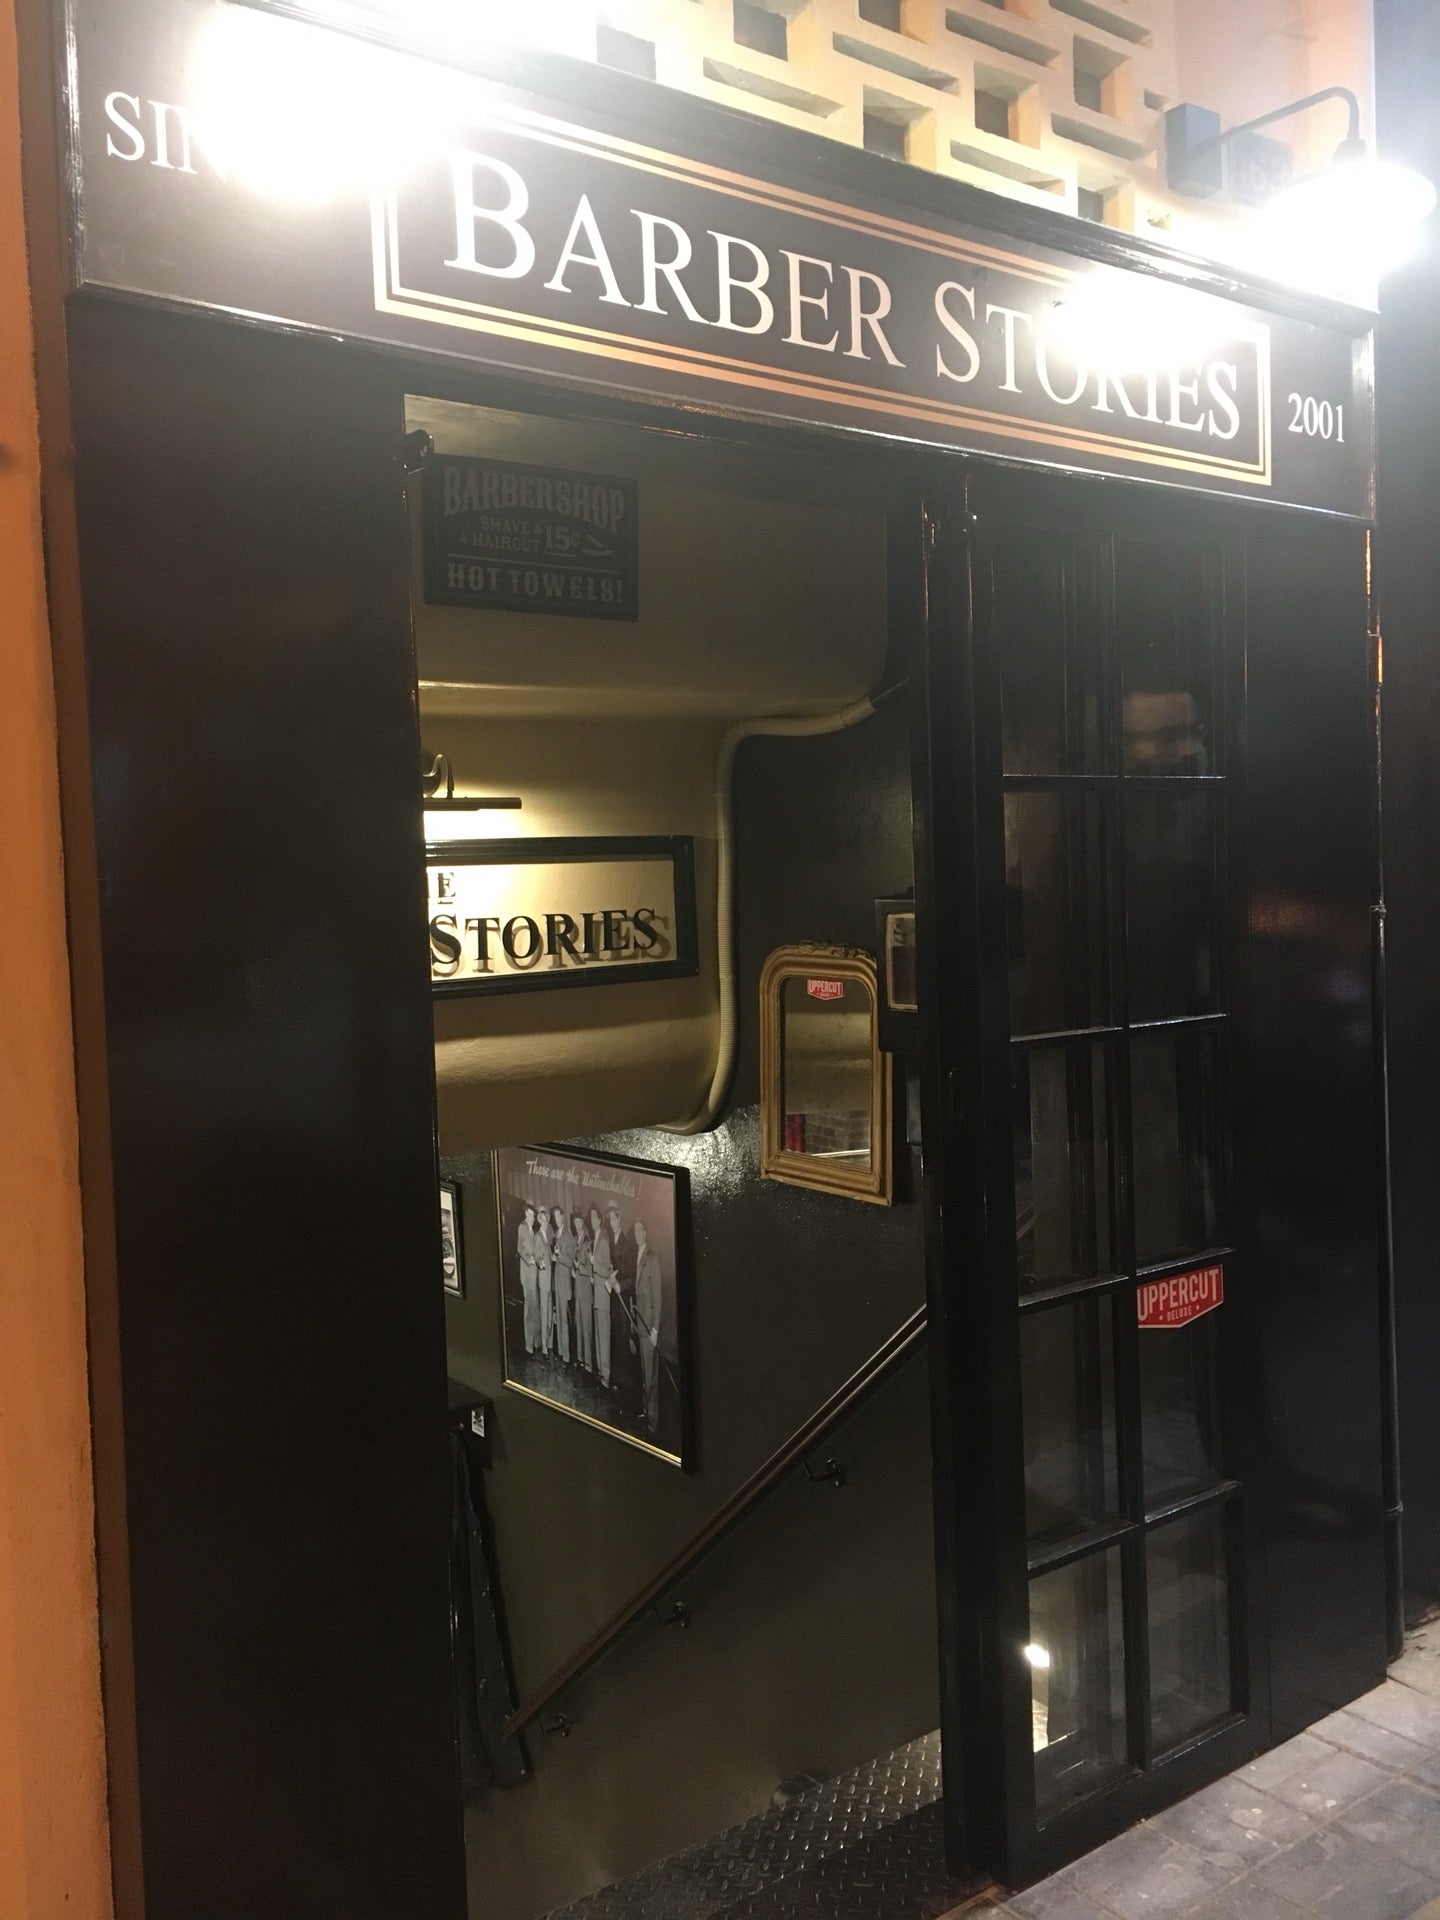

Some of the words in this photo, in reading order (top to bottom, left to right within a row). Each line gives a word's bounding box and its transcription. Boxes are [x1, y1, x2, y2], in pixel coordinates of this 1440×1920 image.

[443, 146, 906, 369] BARBER
[934, 280, 1240, 440] STORIES
[1287, 392, 1346, 443] 2001
[443, 465, 625, 535] BARBERSHOP
[480, 515, 531, 535] SHAVE
[472, 532, 541, 553] HAIRCUT
[448, 562, 500, 592] HOT
[508, 569, 623, 604] TOWELS!
[430, 908, 658, 965] STORIES
[1137, 1268, 1219, 1321] UPPERCUT
[1167, 1305, 1193, 1322] DELUXE
